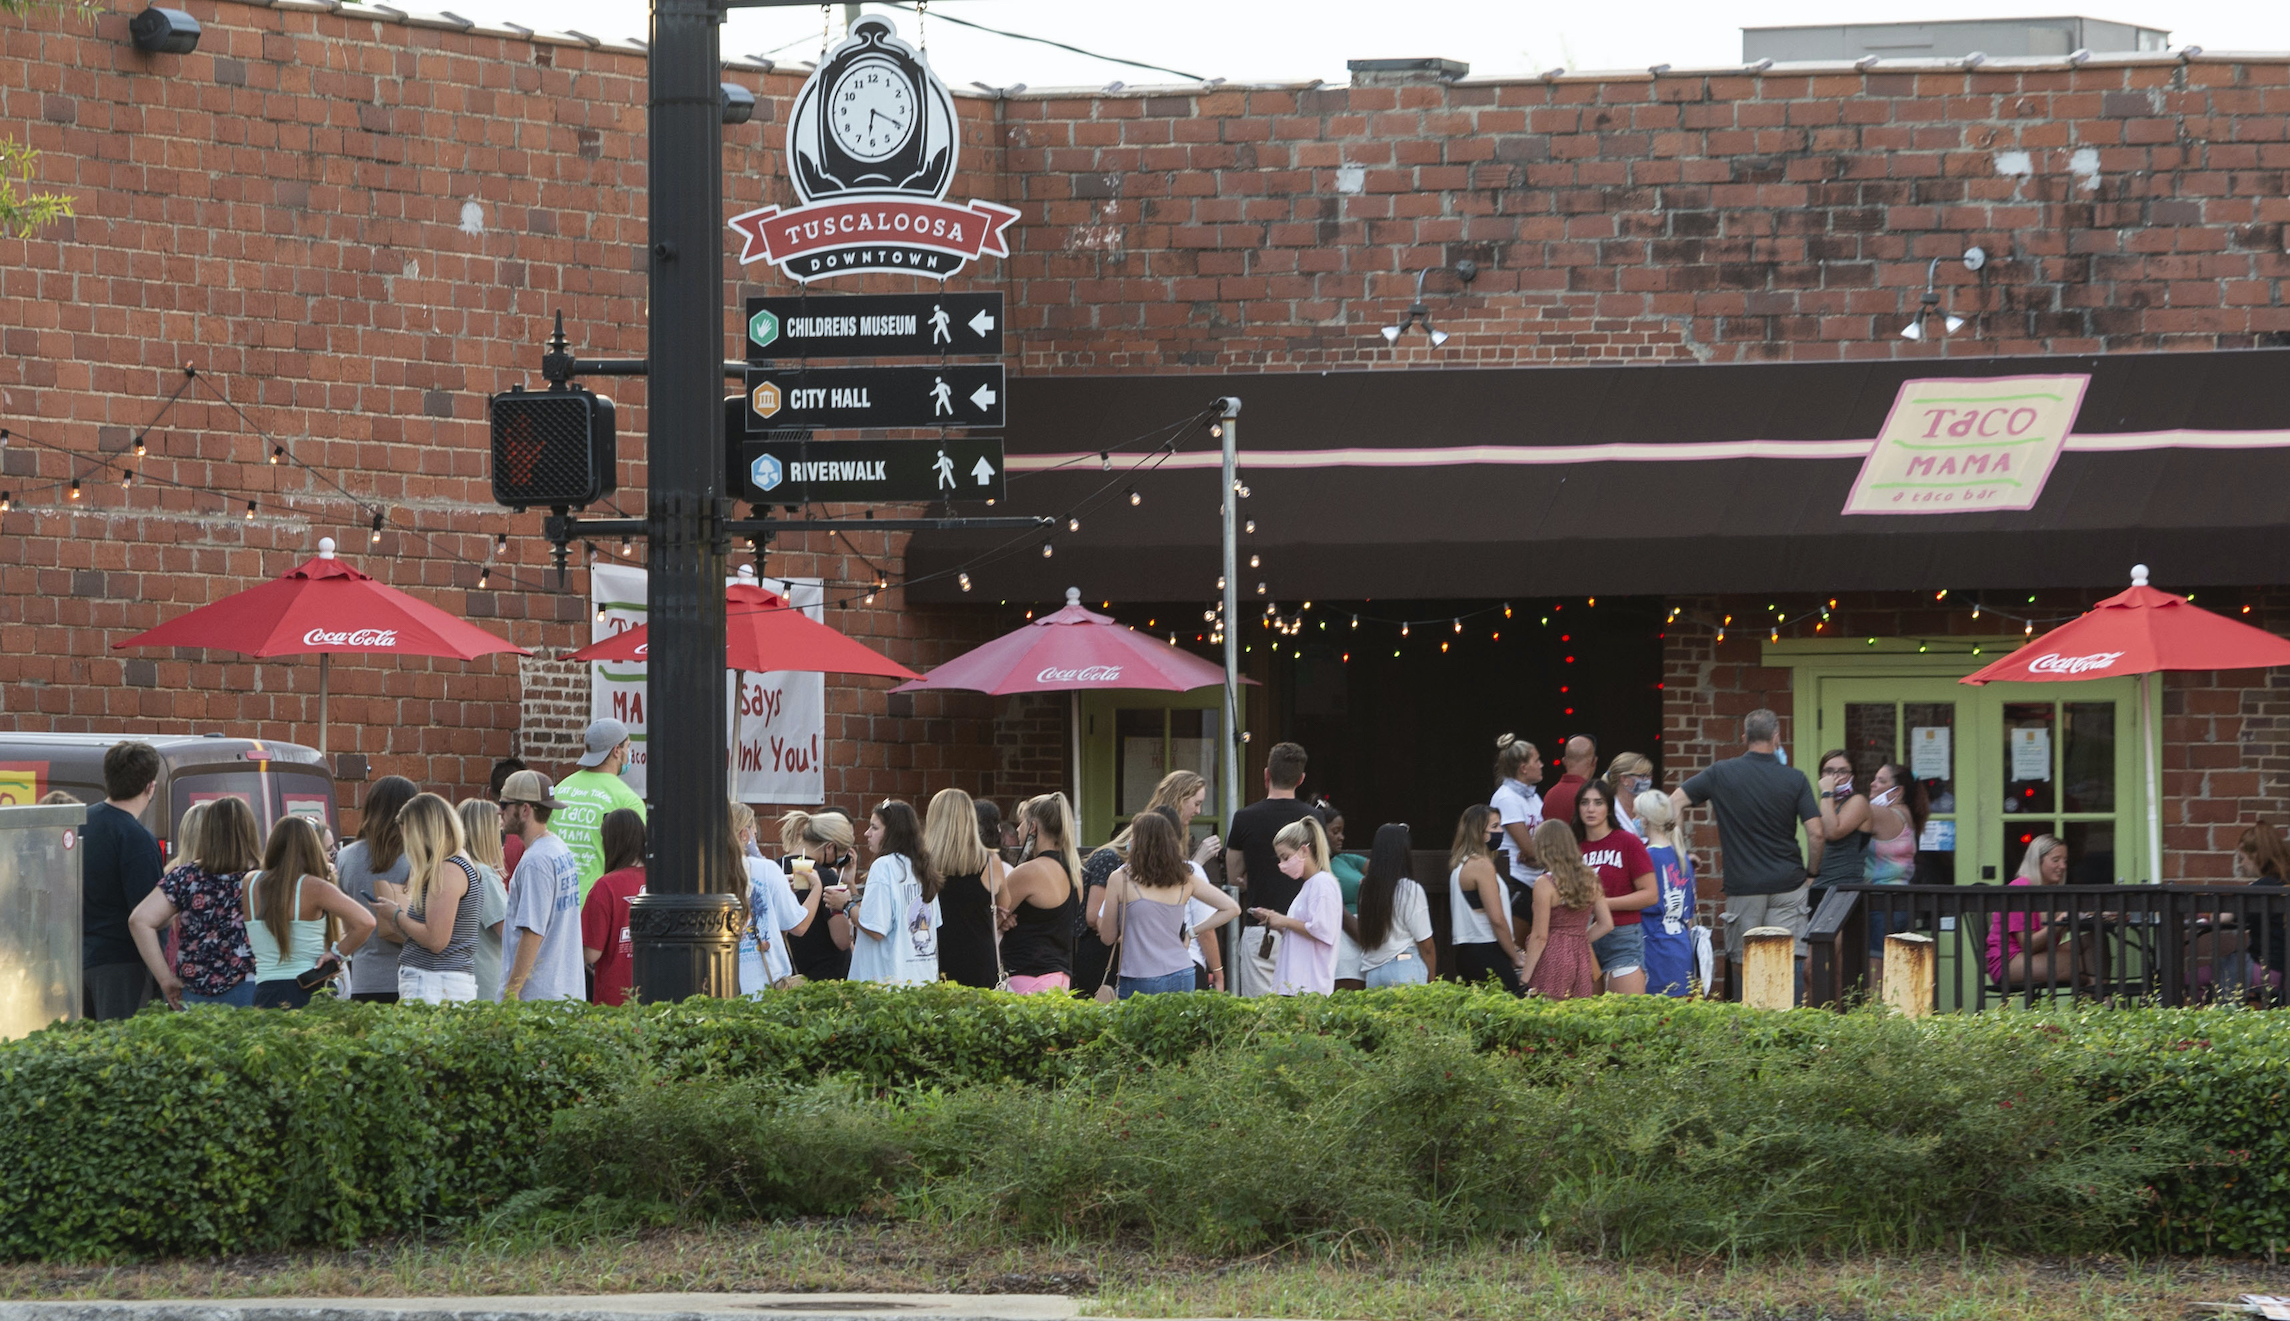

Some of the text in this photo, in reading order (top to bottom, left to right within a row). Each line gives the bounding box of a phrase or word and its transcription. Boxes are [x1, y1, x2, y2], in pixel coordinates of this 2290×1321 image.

[854, 80, 863, 89] 11
[868, 74, 878, 83] 12
[886, 78, 890, 87] 1
[845, 92, 855, 101] 10
[896, 90, 901, 98] 2
[841, 107, 847, 116] 9
[900, 106, 904, 114] 3
[845, 124, 851, 132] 8
[856, 134, 862, 143] 7
[870, 139, 875, 147] 6
[884, 134, 890, 143] 5
[784, 212, 964, 245] TUSCALOOSA
[810, 250, 939, 272] DOWNTOWN
[786, 315, 917, 338] CHILDRENS MUSEUM
[790, 388, 871, 410] CITY HALL
[790, 460, 886, 482] RIVERWALK
[1906, 453, 2010, 476] MAMA
[1892, 488, 1998, 502] a taco bar
[303, 627, 398, 646] Coca-Cola
[1036, 665, 1124, 683] Coca-Cola
[613, 690, 644, 724] MA
[770, 734, 818, 774] You!
[558, 828, 591, 842] MAMA
[1582, 849, 1623, 869] ABAMA
